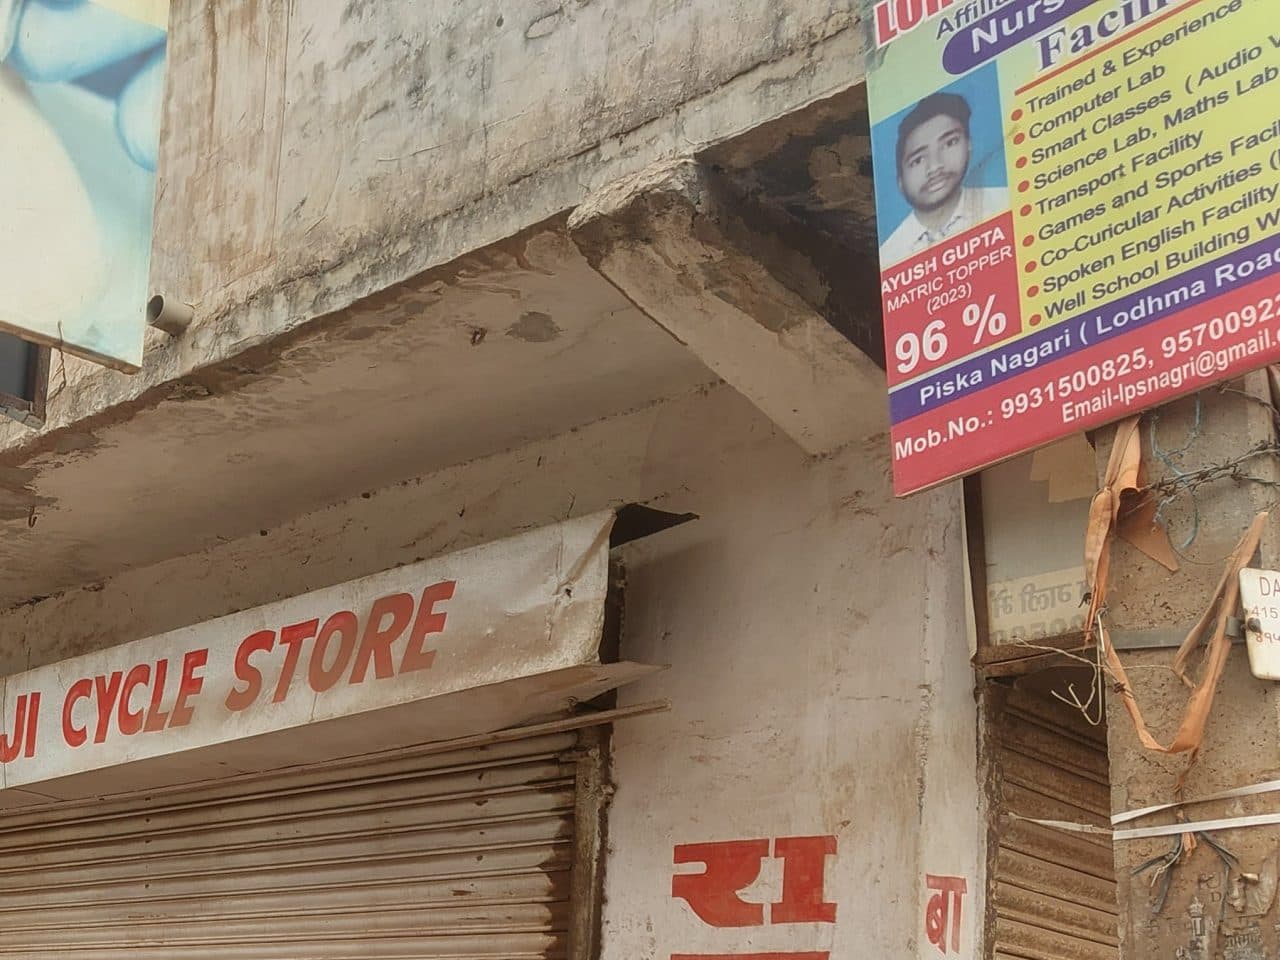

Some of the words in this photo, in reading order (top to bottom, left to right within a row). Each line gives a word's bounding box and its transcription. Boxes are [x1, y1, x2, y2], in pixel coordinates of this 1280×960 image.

[1026, 68, 1096, 114] Trained
[1102, 59, 1117, 77] &
[1029, 84, 1122, 139] Computer
[1127, 64, 1166, 92] Lab
[1032, 127, 1087, 165] Smart
[1092, 89, 1172, 135] Classes
[1198, 46, 1263, 87] Audio
[1033, 147, 1108, 190] Science
[1113, 125, 1157, 153] Lab,
[1164, 90, 1229, 130] Maths
[1236, 66, 1279, 96] Lab
[1035, 163, 1126, 215] Transport
[1131, 130, 1204, 172] Facility
[1038, 203, 1106, 240] Games
[1112, 181, 1149, 209] and
[1155, 150, 1223, 190] Sports
[1230, 117, 1280, 156] Facil
[1040, 204, 1162, 267] Co-Curicular
[1166, 162, 1262, 214] Activities
[881, 256, 938, 295] AYUSH
[942, 226, 1006, 266] GUPTA
[886, 275, 945, 313] MATRIC
[947, 245, 1013, 285] TOPPER
[1043, 254, 1115, 294] Spoken
[1121, 219, 1196, 261] English
[1202, 184, 1280, 227] Facility
[1044, 290, 1086, 319] Well
[1092, 260, 1160, 301] School
[1166, 225, 1250, 271] Building
[919, 367, 984, 406] Piska
[990, 328, 1072, 377] Nagari
[1095, 278, 1207, 336] Lodhma
[926, 282, 973, 316] (2023)
[894, 319, 949, 375] 96
[999, 347, 1155, 420] 9931500825,
[61, 648, 209, 749] CYCLE
[223, 579, 458, 714] STORE
